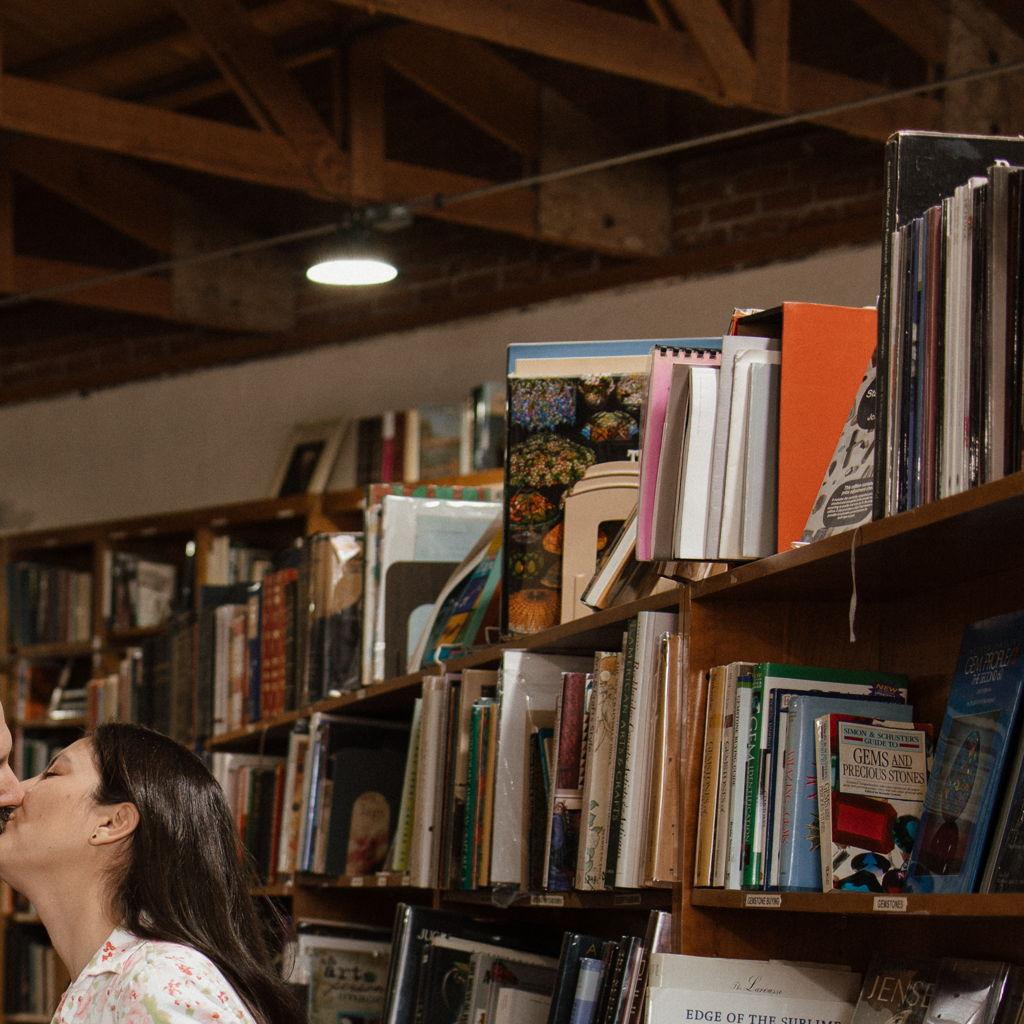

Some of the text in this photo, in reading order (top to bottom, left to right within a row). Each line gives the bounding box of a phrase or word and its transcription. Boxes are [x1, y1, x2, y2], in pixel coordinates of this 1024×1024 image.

[844, 728, 867, 737] SIMON
[864, 739, 886, 747] GUIDE
[853, 748, 913, 768] GEMS AND
[744, 716, 758, 842] GEM IDENTIFICATION
[843, 764, 925, 785] PRECIOUS STONES
[877, 899, 904, 909] GEMSTONES
[686, 1009, 722, 1022] EDGE
[726, 1012, 745, 1023] OF
